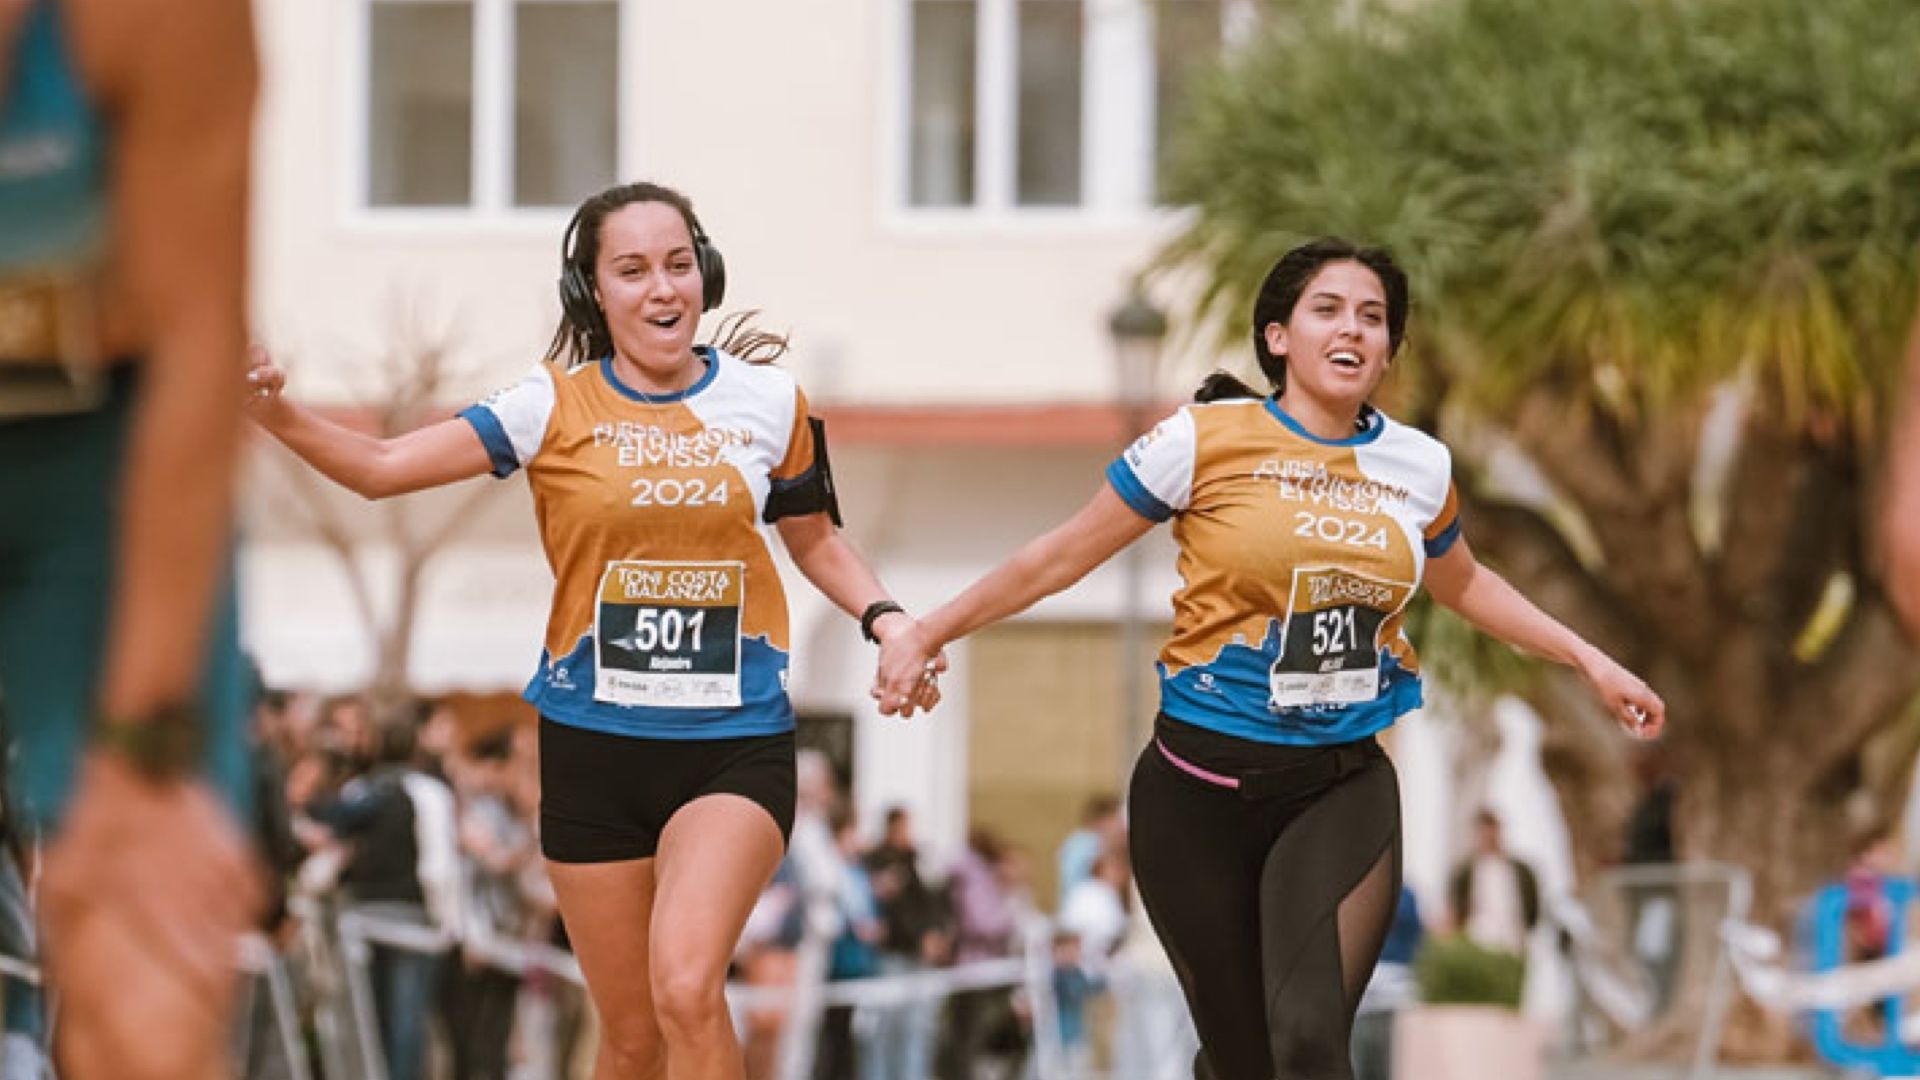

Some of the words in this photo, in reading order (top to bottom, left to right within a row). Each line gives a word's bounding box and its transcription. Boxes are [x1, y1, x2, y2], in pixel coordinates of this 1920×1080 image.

[631, 478, 728, 506] 2024
[1294, 511, 1388, 550] 2024
[618, 568, 663, 585] TONI
[668, 570, 730, 586] COSTA
[635, 608, 704, 651] 501
[1312, 606, 1357, 655] 521
